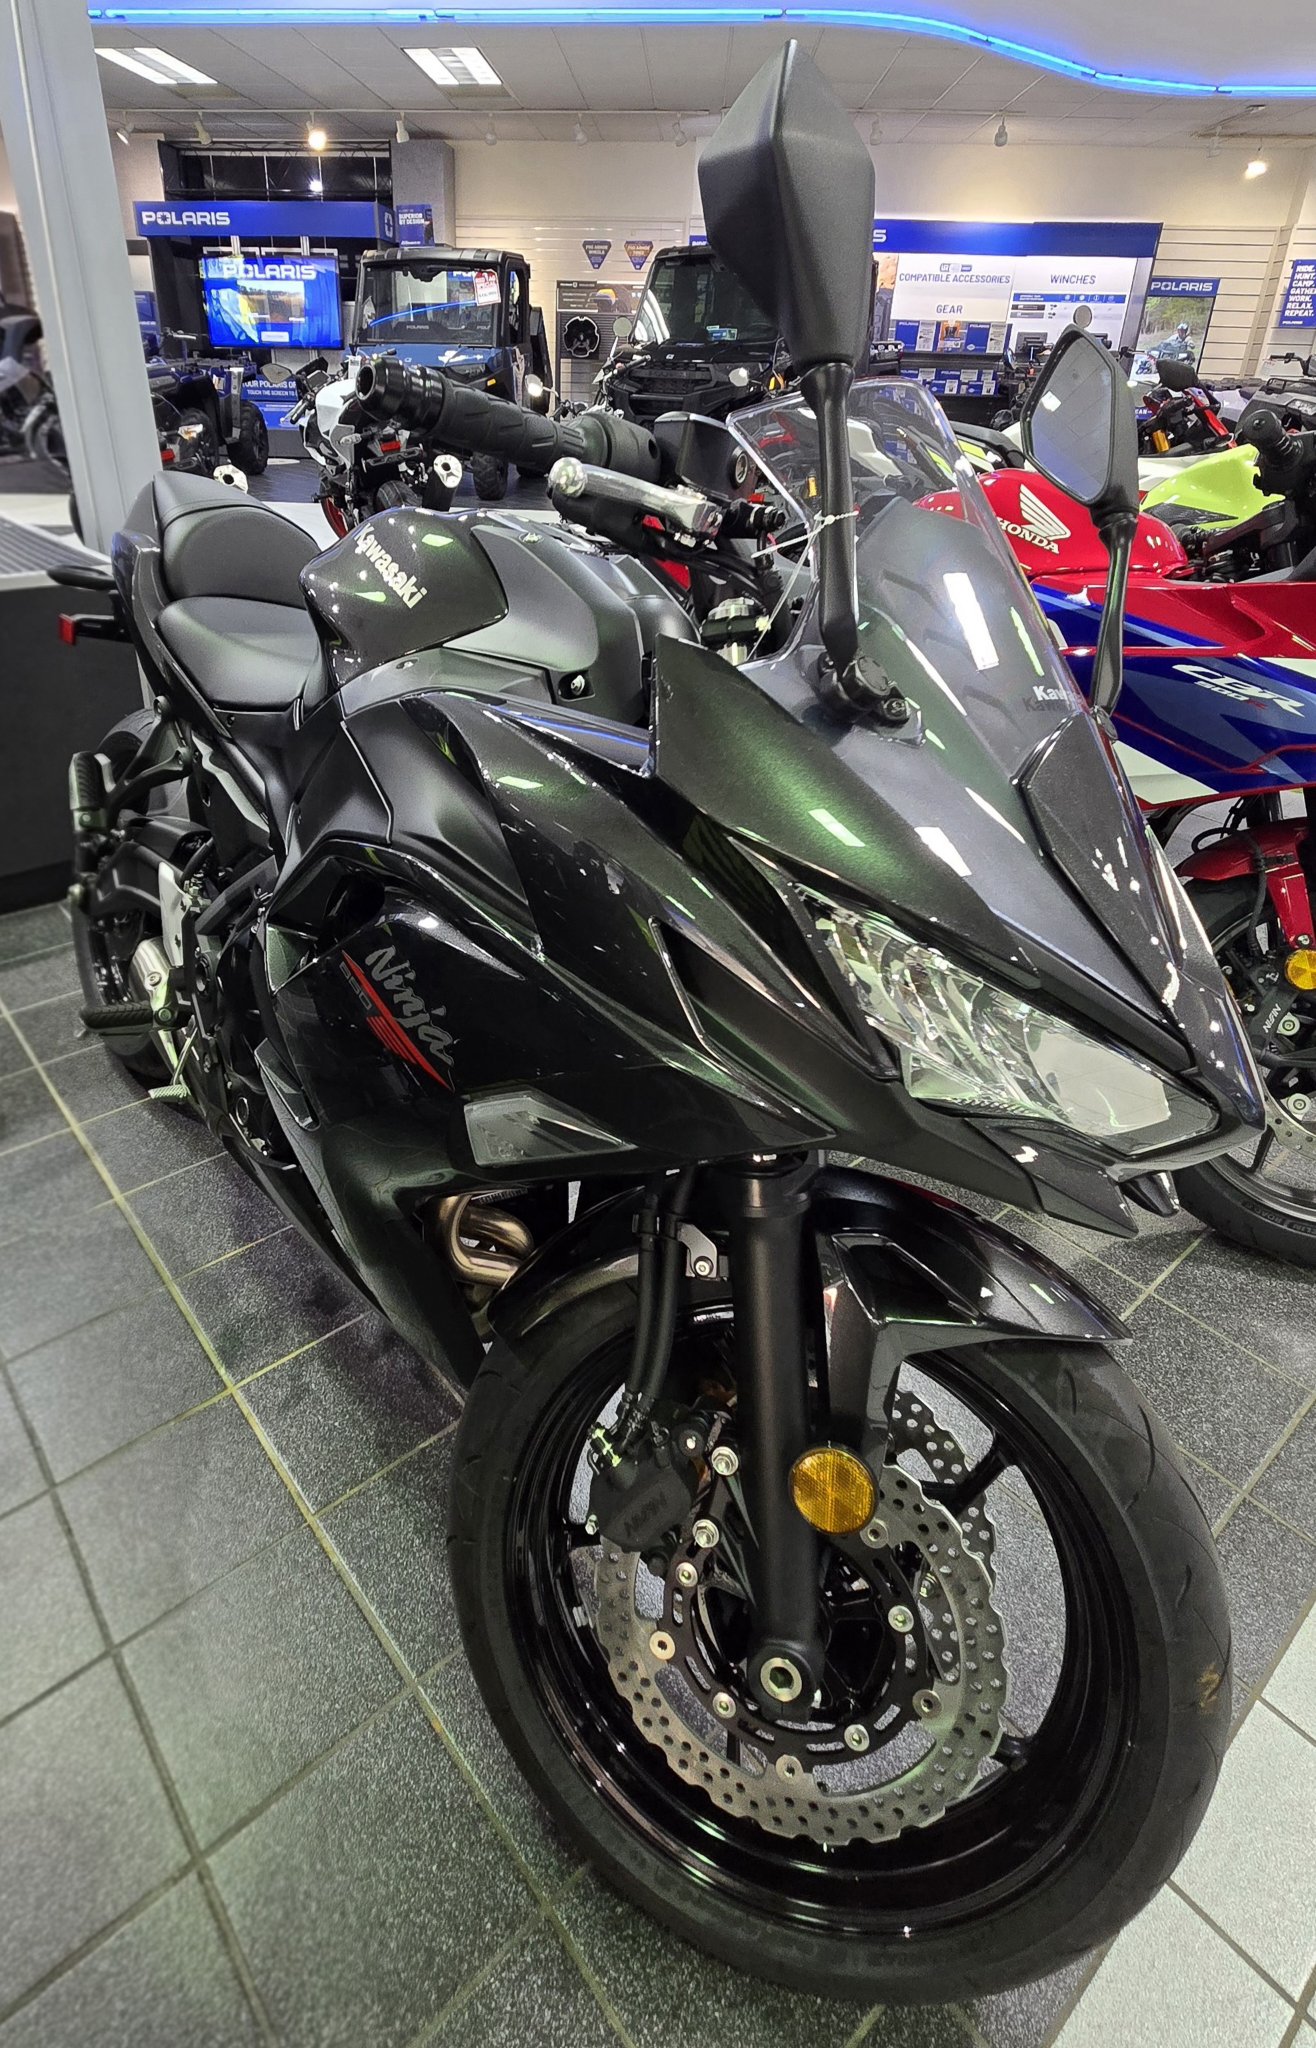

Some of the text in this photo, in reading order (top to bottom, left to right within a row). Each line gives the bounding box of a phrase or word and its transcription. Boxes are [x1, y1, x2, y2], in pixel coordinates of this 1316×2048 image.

[141, 211, 231, 225] POLARIS
[223, 263, 317, 280] POLARIS
[899, 273, 1011, 284] COMPATIBLE ACCESSORIES
[1050, 274, 1096, 284] WINCHES
[1151, 281, 1214, 292] POLARIS
[936, 305, 963, 314] GEAR
[997, 516, 1060, 555] HONDA
[354, 522, 428, 609] Kawasaki
[1172, 664, 1305, 718] CBR
[338, 961, 373, 1011] 650
[364, 945, 456, 1068] Ninja
